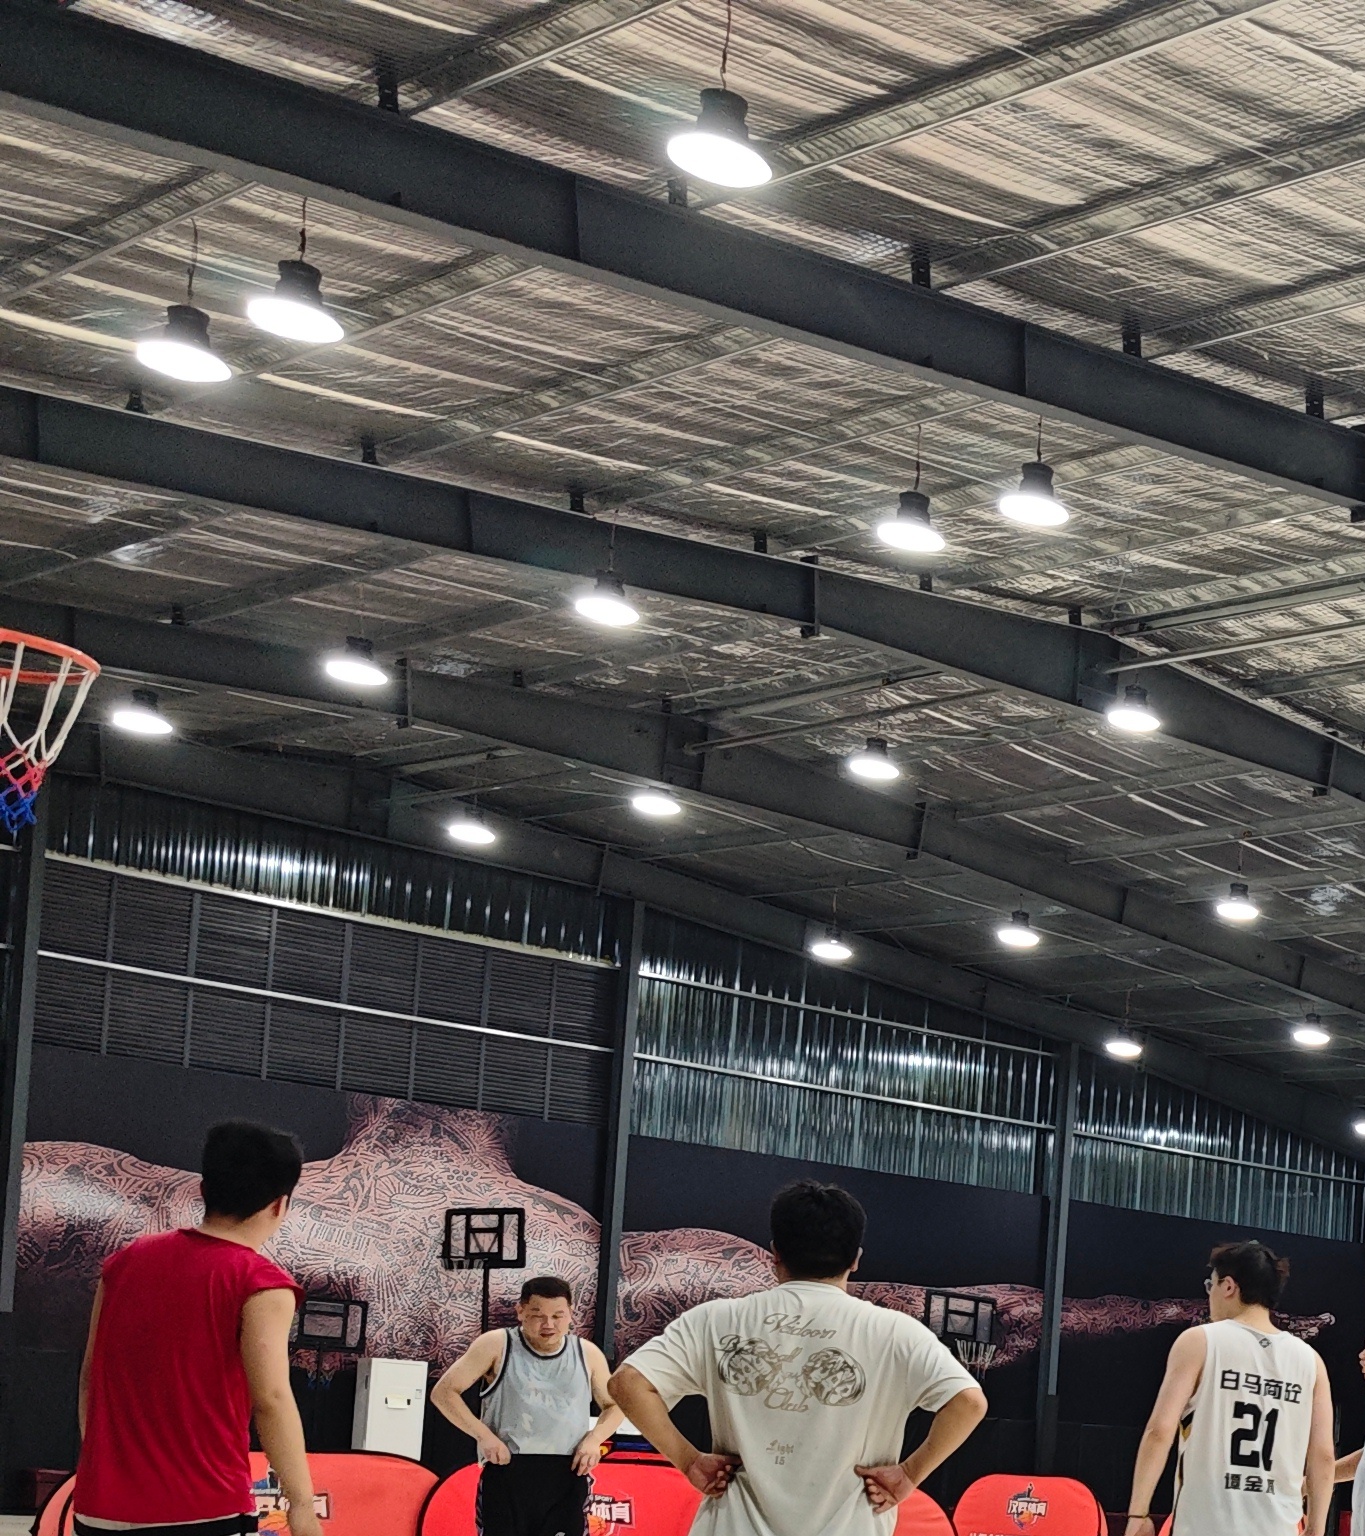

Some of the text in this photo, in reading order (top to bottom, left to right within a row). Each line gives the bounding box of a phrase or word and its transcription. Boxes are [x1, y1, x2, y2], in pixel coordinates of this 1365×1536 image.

[1220, 1369, 1302, 1404] 白马商砼
[1230, 1401, 1280, 1472] 21
